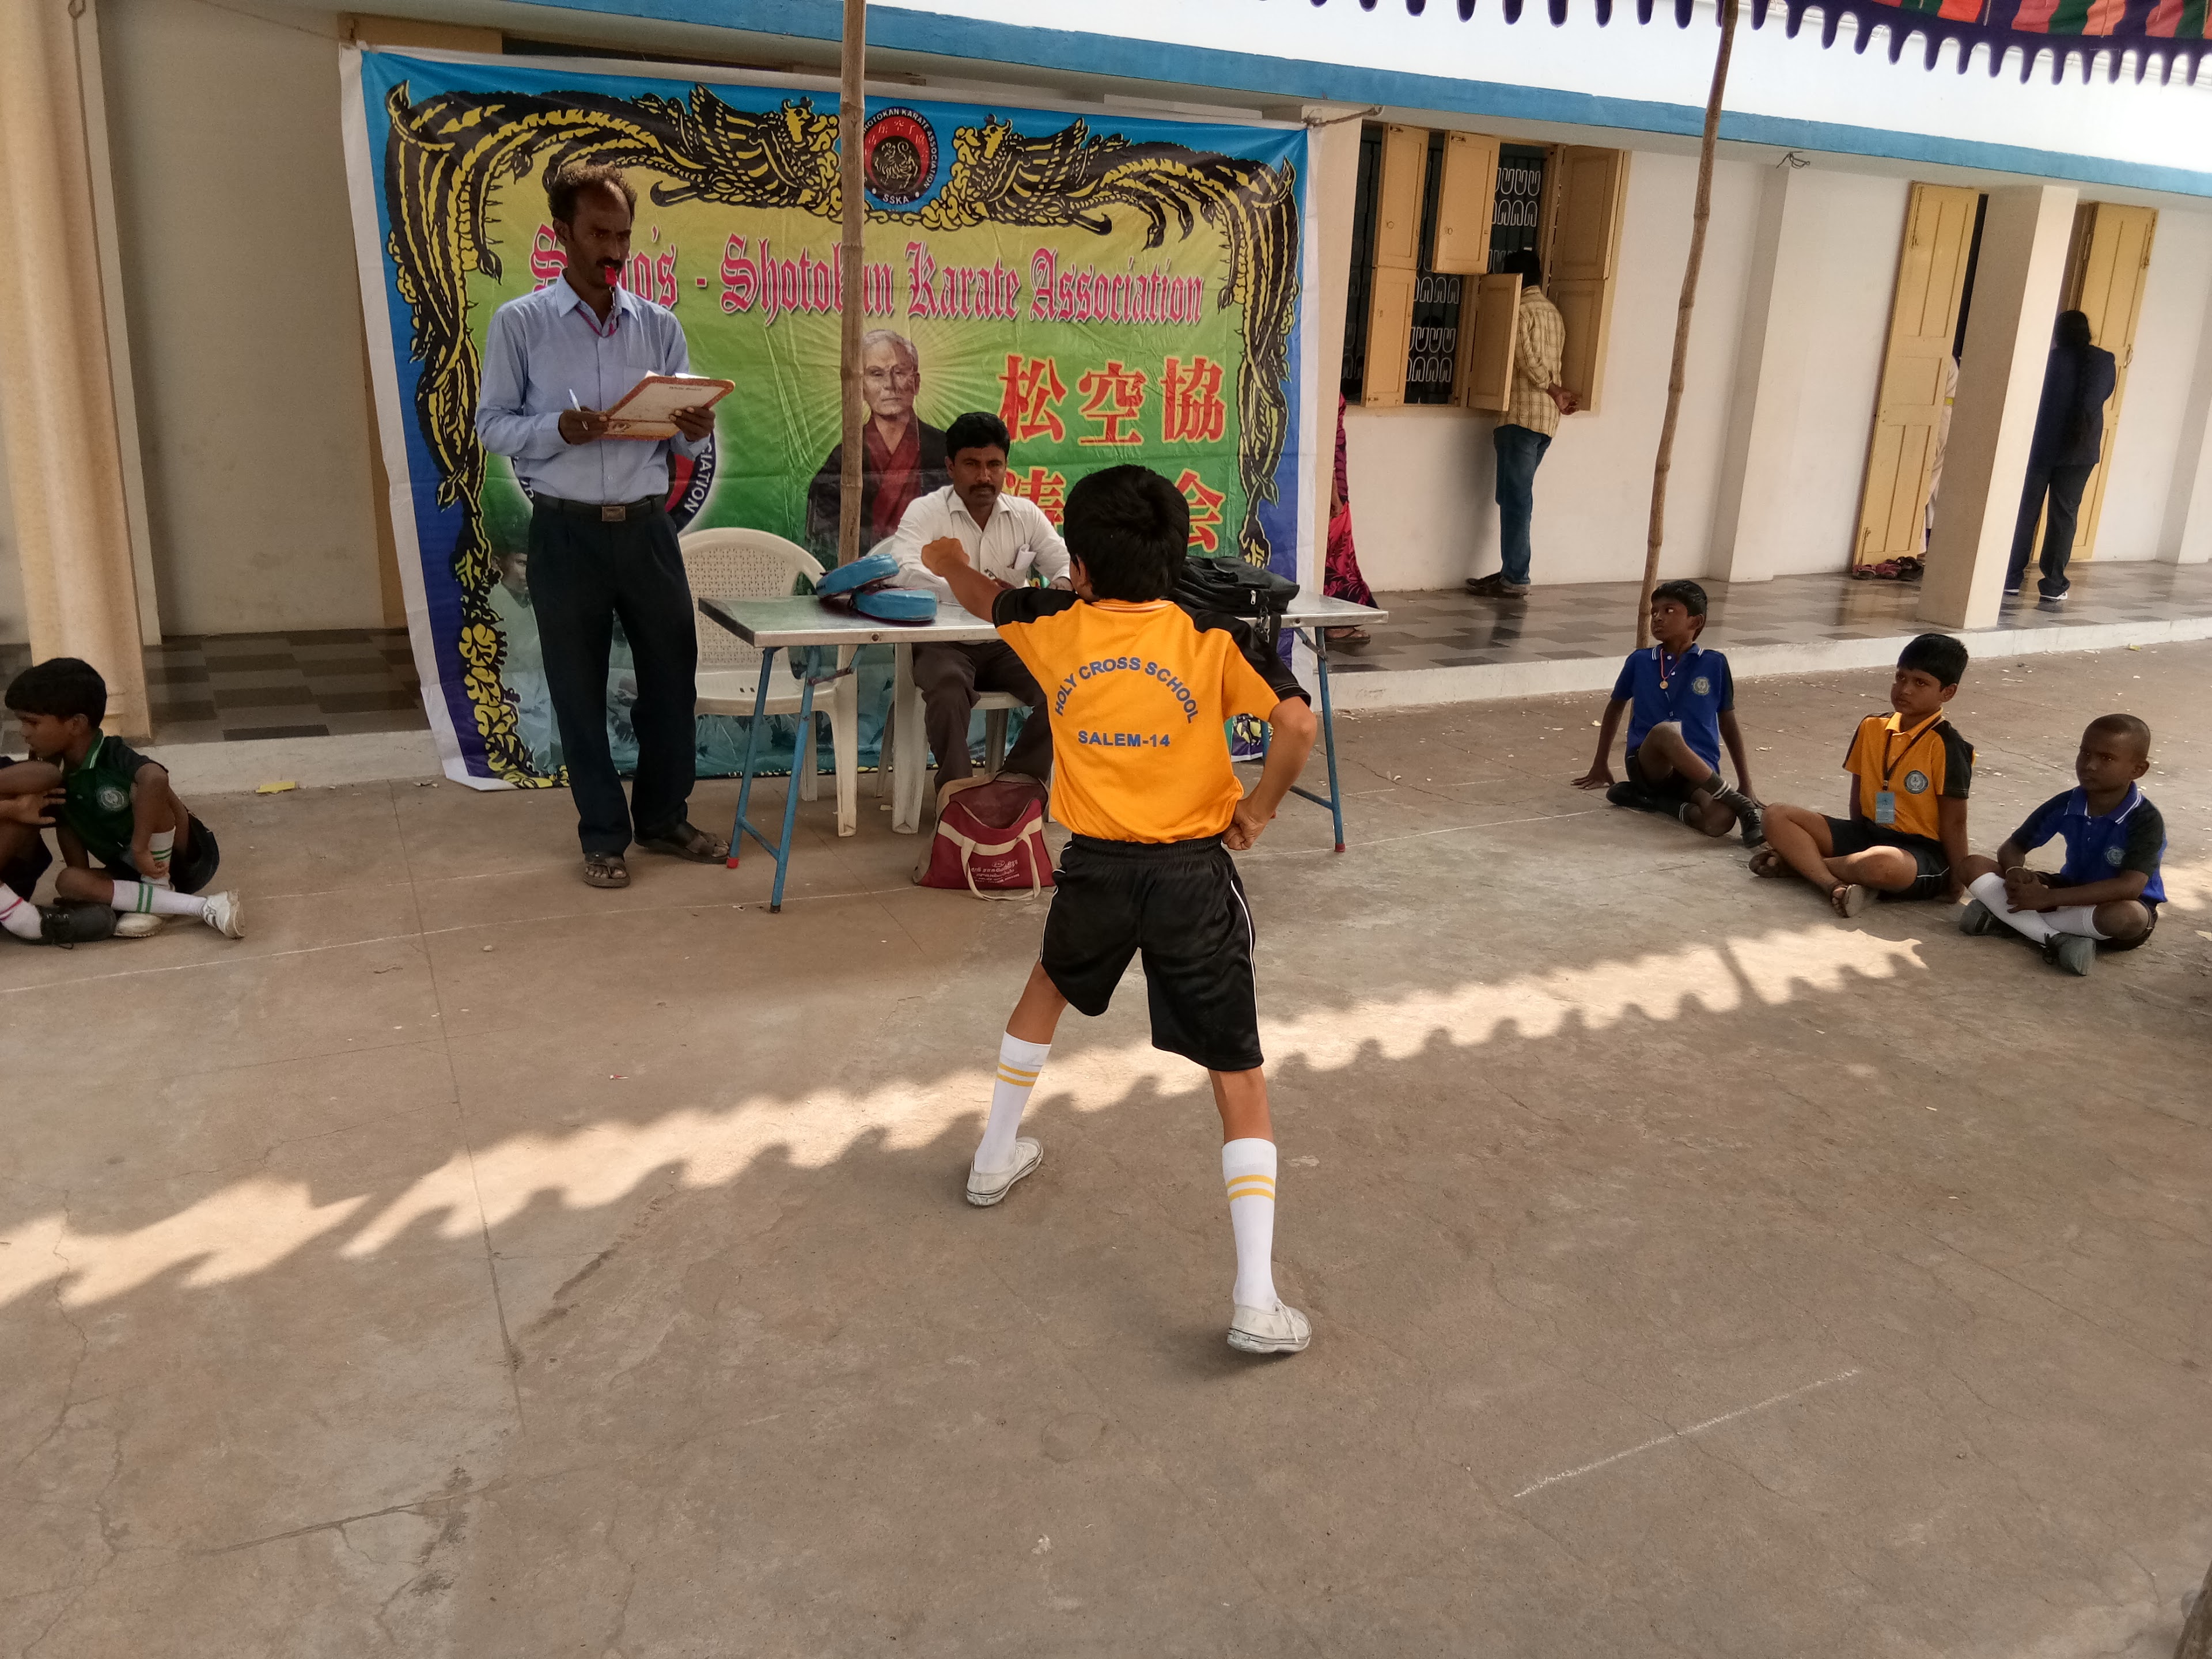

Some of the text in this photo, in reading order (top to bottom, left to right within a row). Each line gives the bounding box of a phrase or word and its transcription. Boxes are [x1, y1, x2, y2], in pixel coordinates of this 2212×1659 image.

[902, 109, 930, 130] KARATE
[923, 131, 937, 188] ASSOCIATION
[883, 194, 909, 204] SSKA
[905, 241, 1021, 320] Karate
[1030, 248, 1205, 326] Association
[1055, 657, 1199, 724] HOLY CROSS SCHOOL
[1078, 730, 1171, 747] SALEM-14
